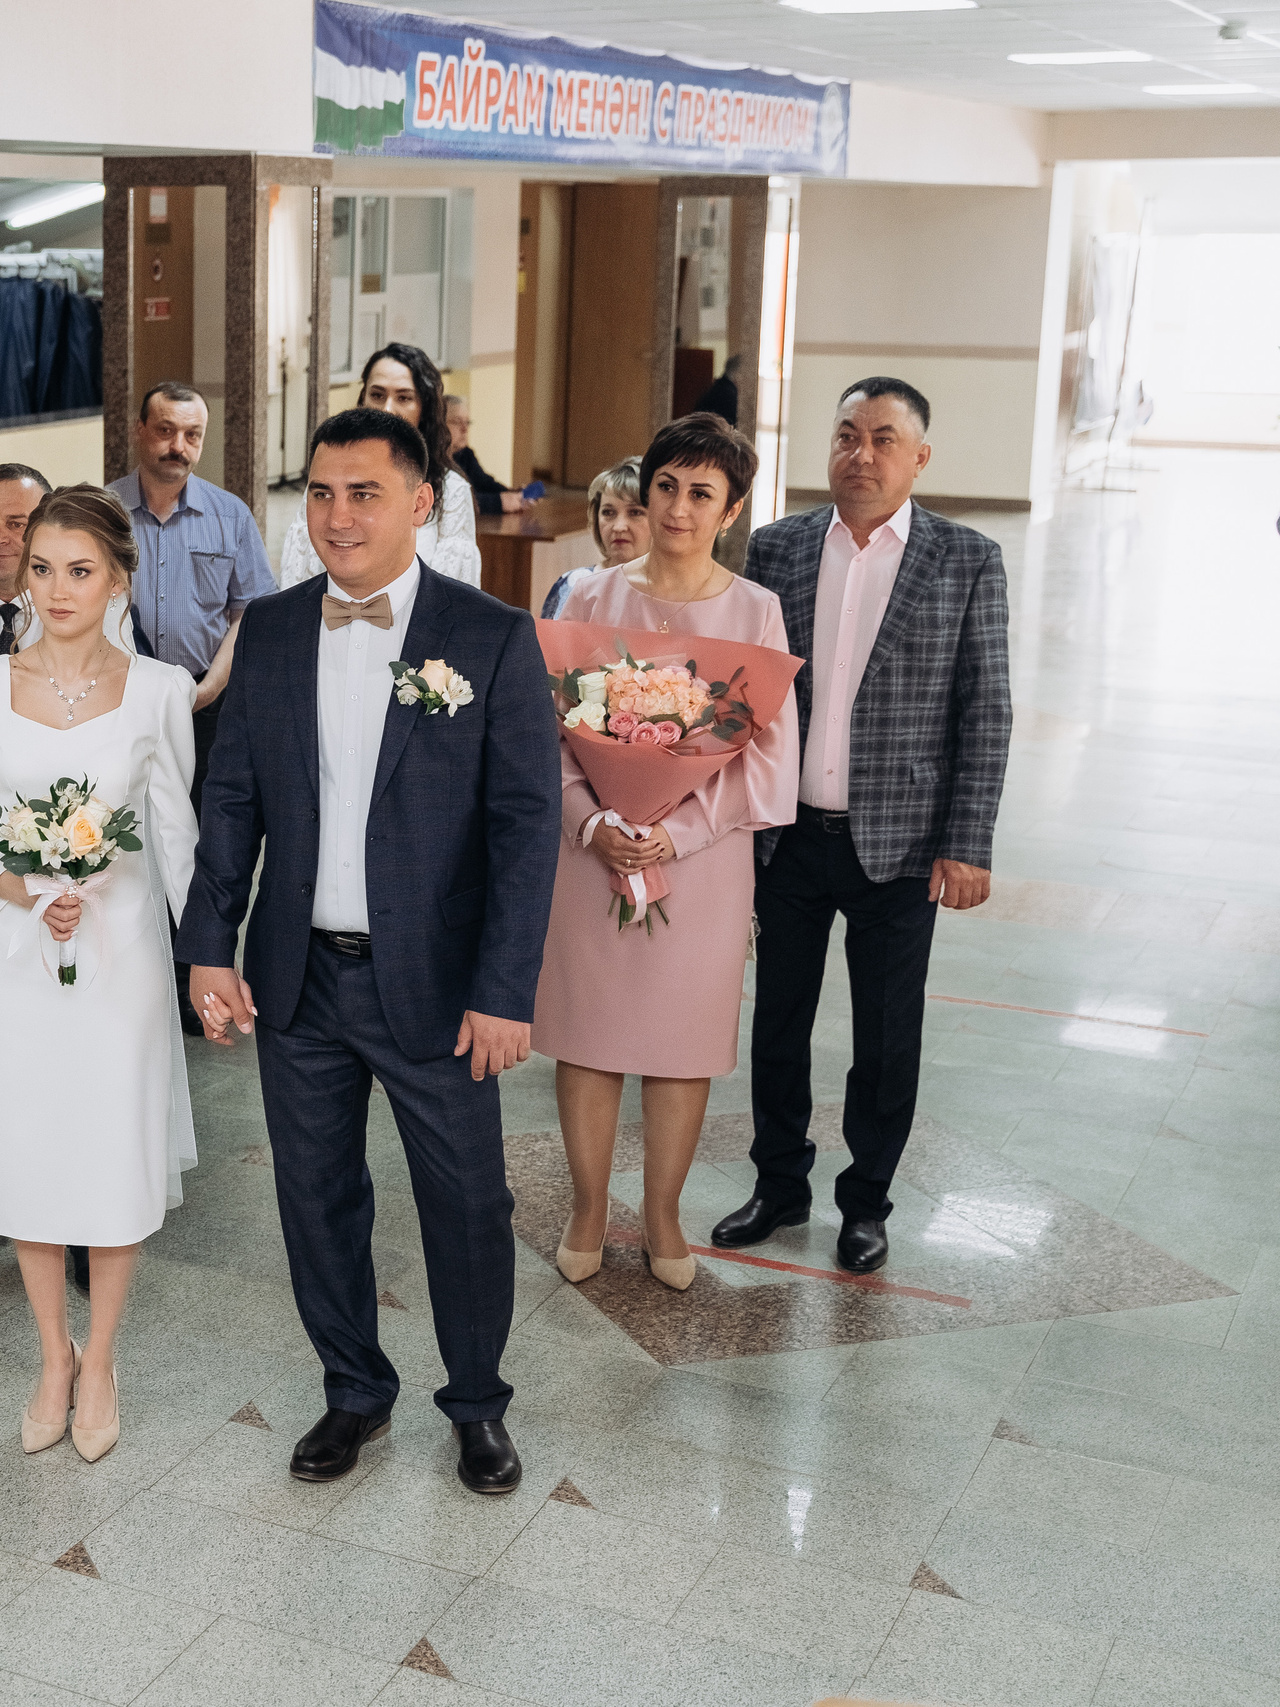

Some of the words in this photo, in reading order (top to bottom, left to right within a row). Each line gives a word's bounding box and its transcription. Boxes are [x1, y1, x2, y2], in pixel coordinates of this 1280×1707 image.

[416, 44, 545, 130] БАЙРАМ
[553, 74, 650, 138] МЕНӘН!
[657, 86, 672, 139] С
